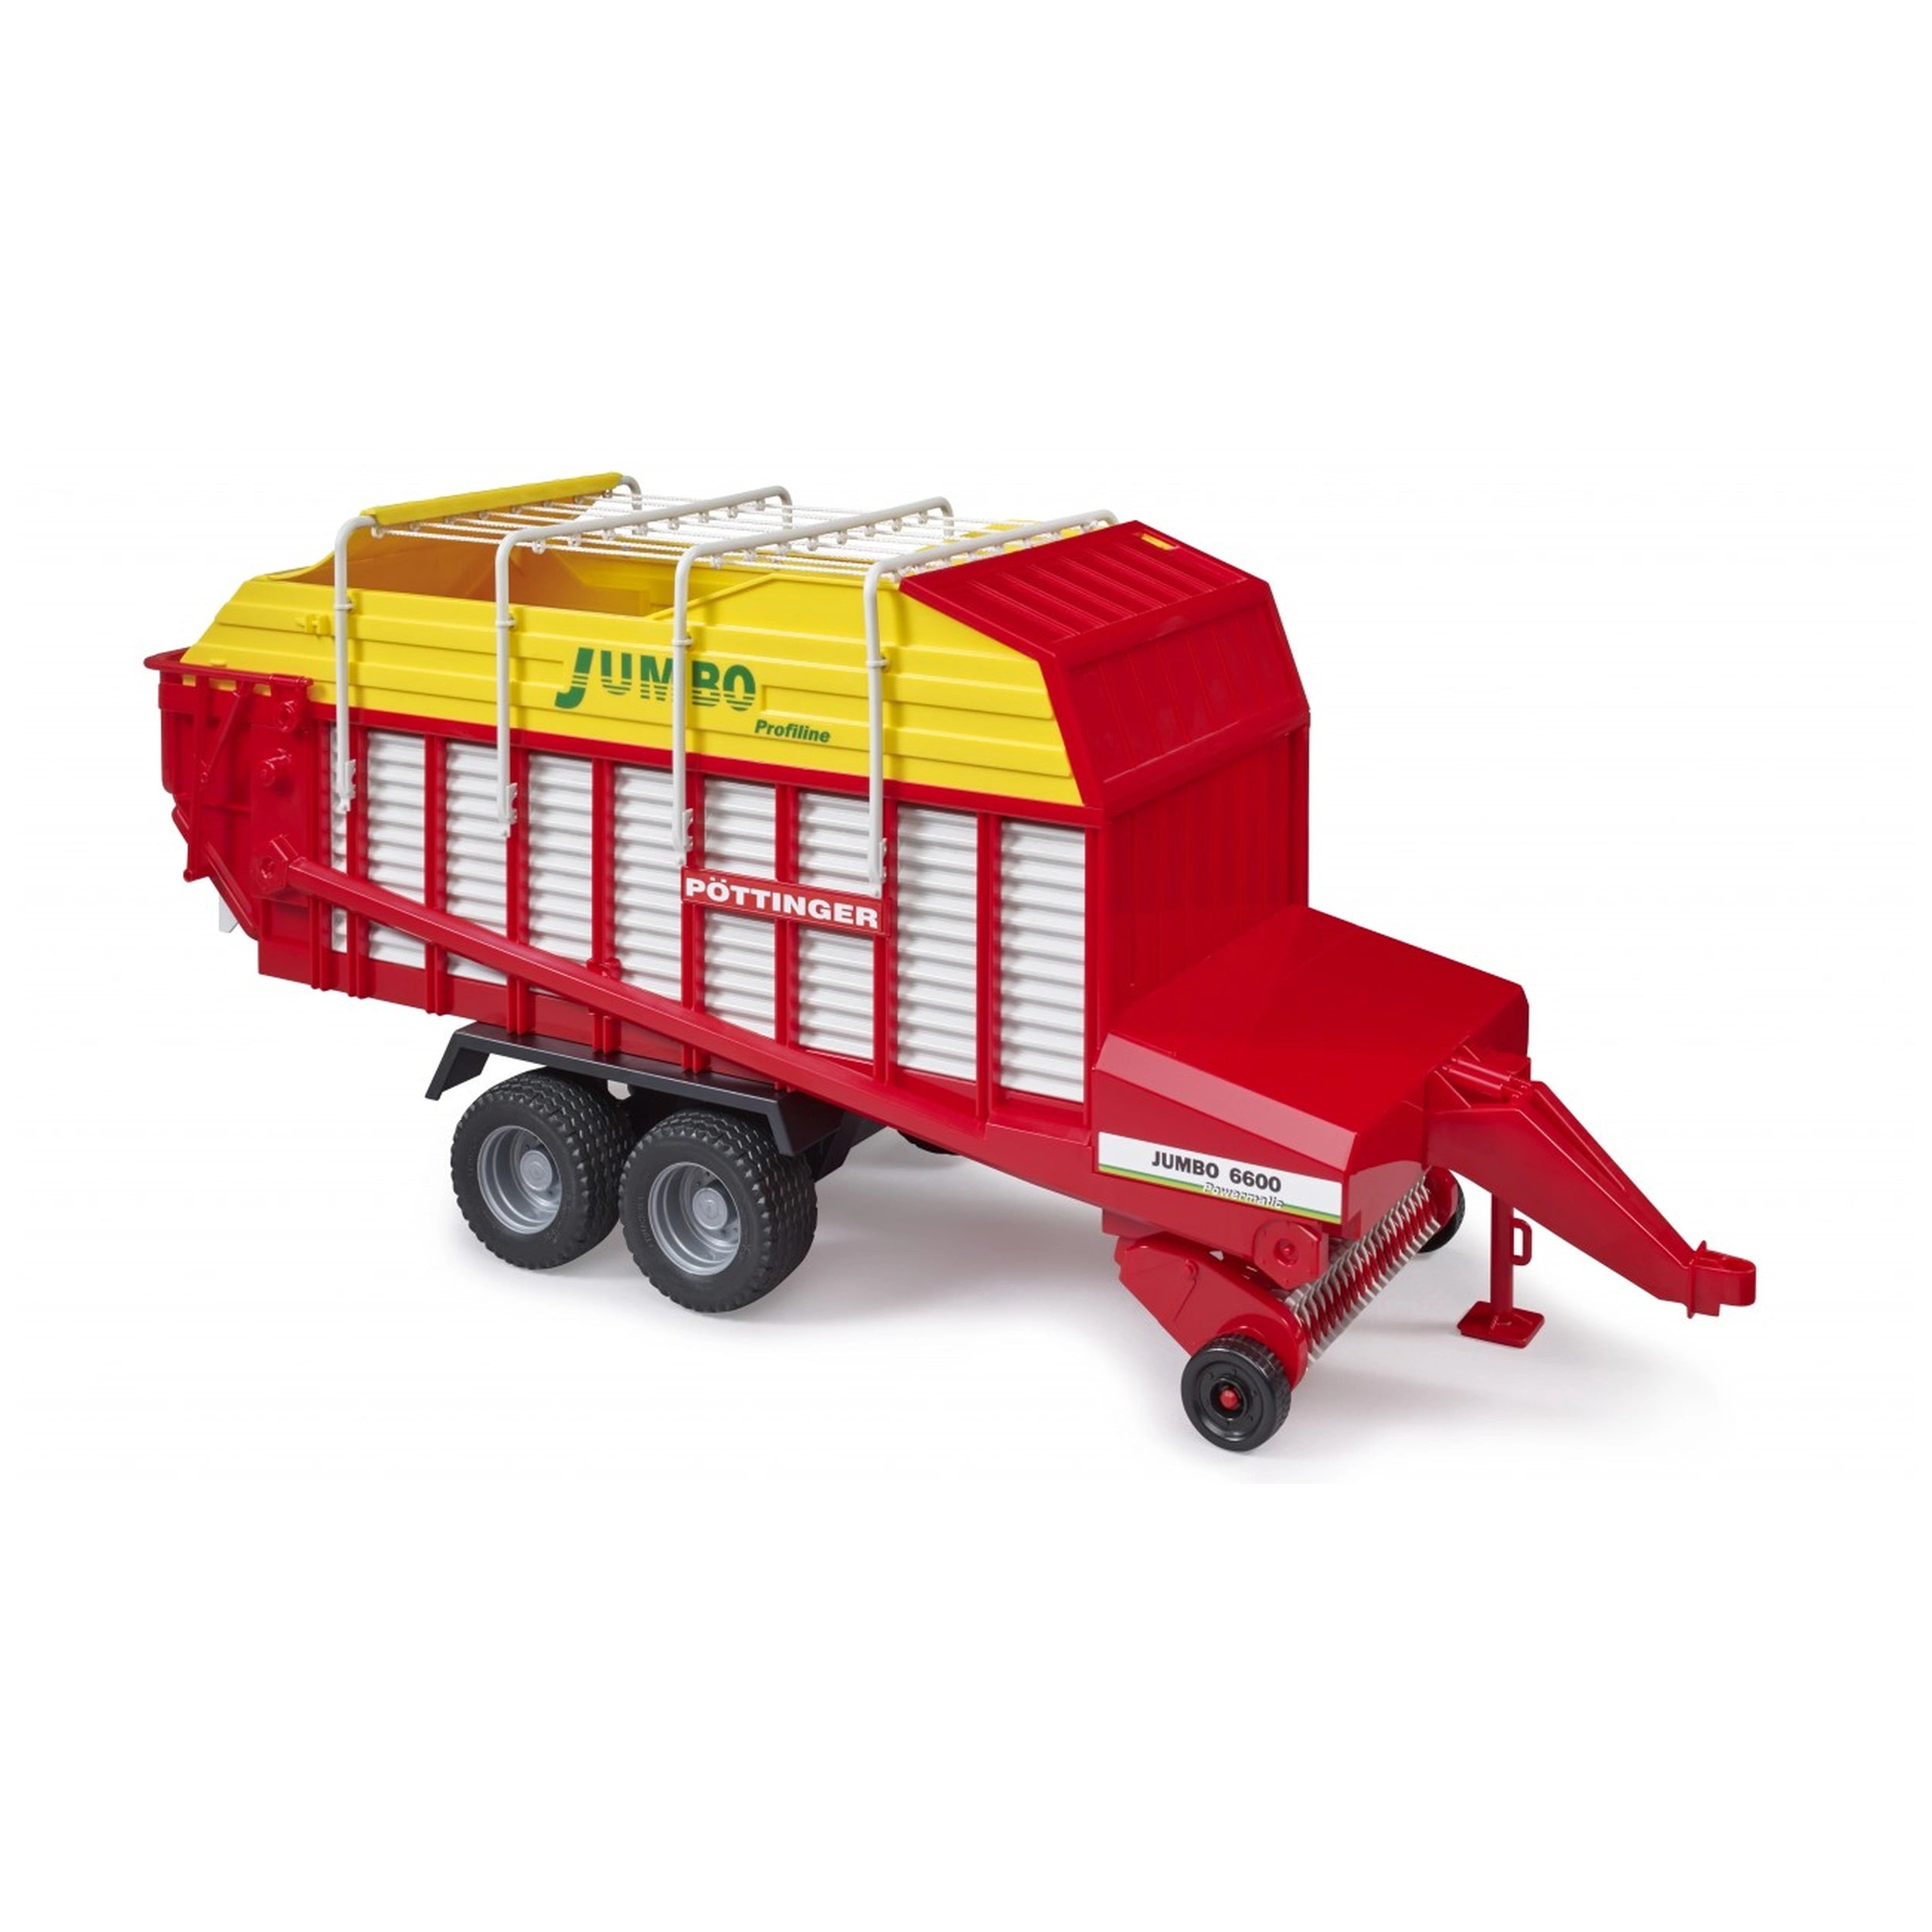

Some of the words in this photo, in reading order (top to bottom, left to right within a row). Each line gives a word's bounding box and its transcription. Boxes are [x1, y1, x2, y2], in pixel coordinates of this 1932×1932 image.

[555, 647, 756, 711] JUMBO
[754, 719, 831, 743] Profiline
[685, 876, 879, 927] PÖTTINGER
[1151, 1151, 1219, 1179] JUMBO
[1229, 1168, 1281, 1192] 6600
[1202, 1182, 1284, 1209] Powermatic
